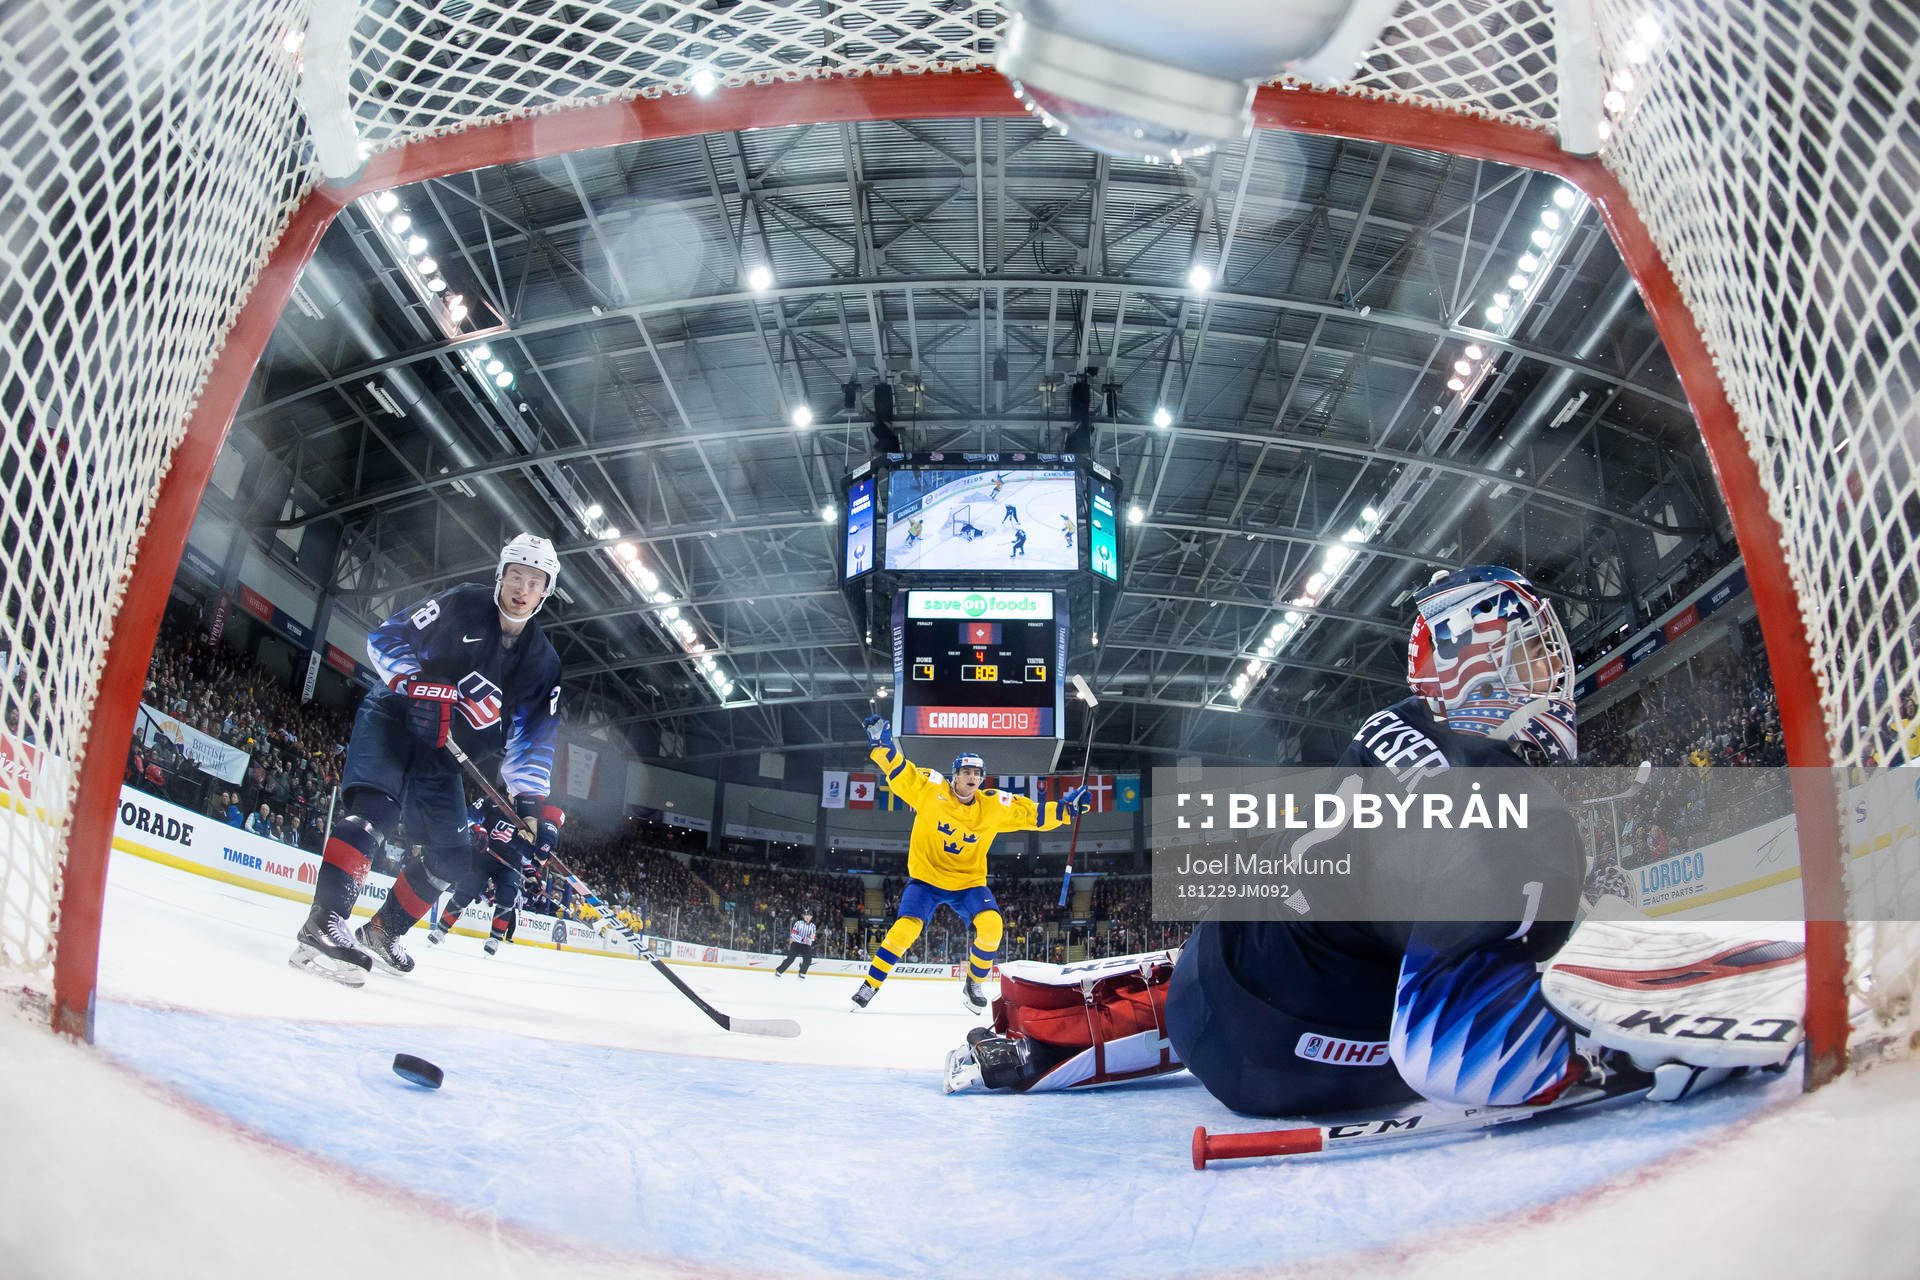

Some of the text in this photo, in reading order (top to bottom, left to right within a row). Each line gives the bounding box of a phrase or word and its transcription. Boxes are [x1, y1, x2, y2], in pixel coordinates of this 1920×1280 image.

[975, 651, 984, 662] 4
[923, 666, 933, 679] 4
[1035, 666, 1045, 680] 4
[929, 712, 1029, 729] CANADA 2019
[192, 738, 226, 762] BRITISH
[1353, 710, 1451, 794] EYSER
[118, 799, 194, 847] ORADE
[223, 847, 295, 879] TIMBER MART
[1641, 852, 1705, 896] LORDCO
[1651, 887, 1694, 904] AUTO PARTS
[464, 907, 492, 920] AIR CAN
[528, 917, 551, 931] TISSOT
[577, 928, 596, 938] TISSOT
[894, 966, 944, 975] BAUER
[1617, 1010, 1797, 1042] CCM
[1322, 1041, 1388, 1063] IIHF
[1329, 1116, 1423, 1139] CM
